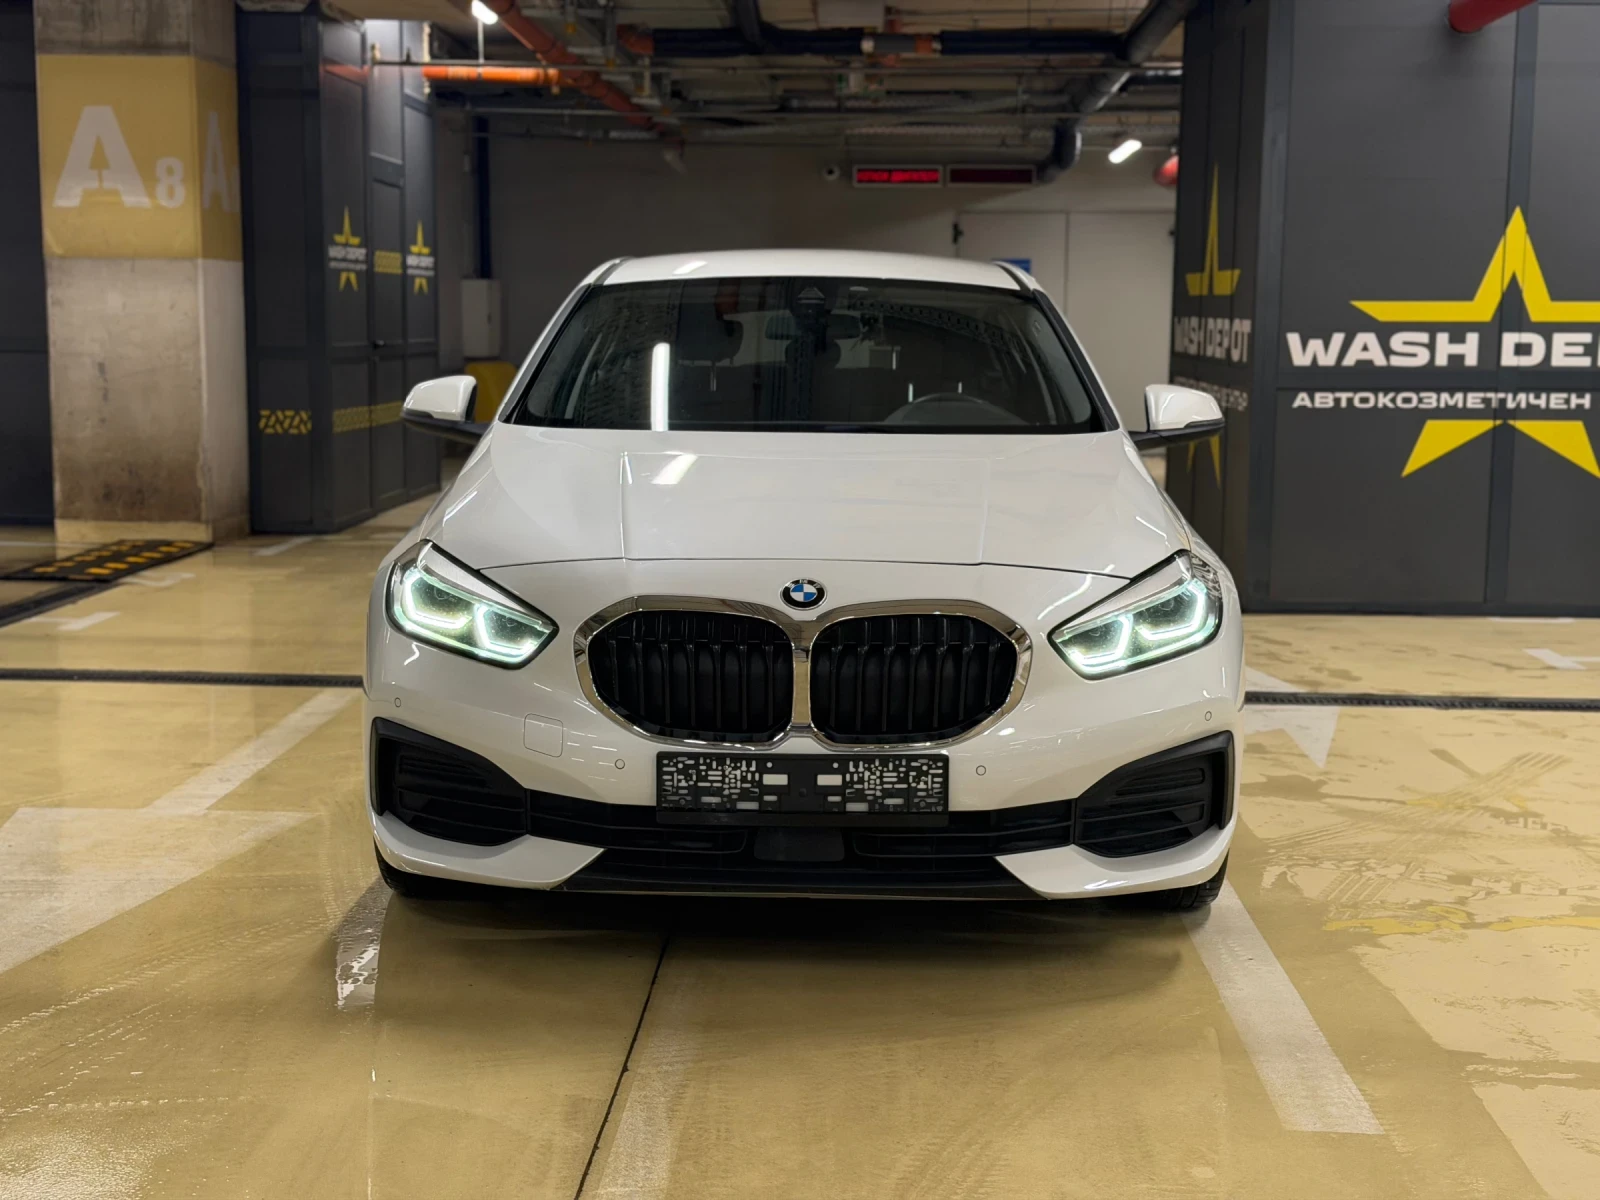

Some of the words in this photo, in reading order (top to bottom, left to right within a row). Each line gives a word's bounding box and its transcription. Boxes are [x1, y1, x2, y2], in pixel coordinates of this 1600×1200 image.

[1173, 316, 1205, 357] WASH
[1205, 317, 1252, 363] DEPOT
[1287, 332, 1479, 367] WASH
[1501, 332, 1600, 367] DE
[1293, 392, 1591, 409] АВТОКОЗМЕТИЧЕН
